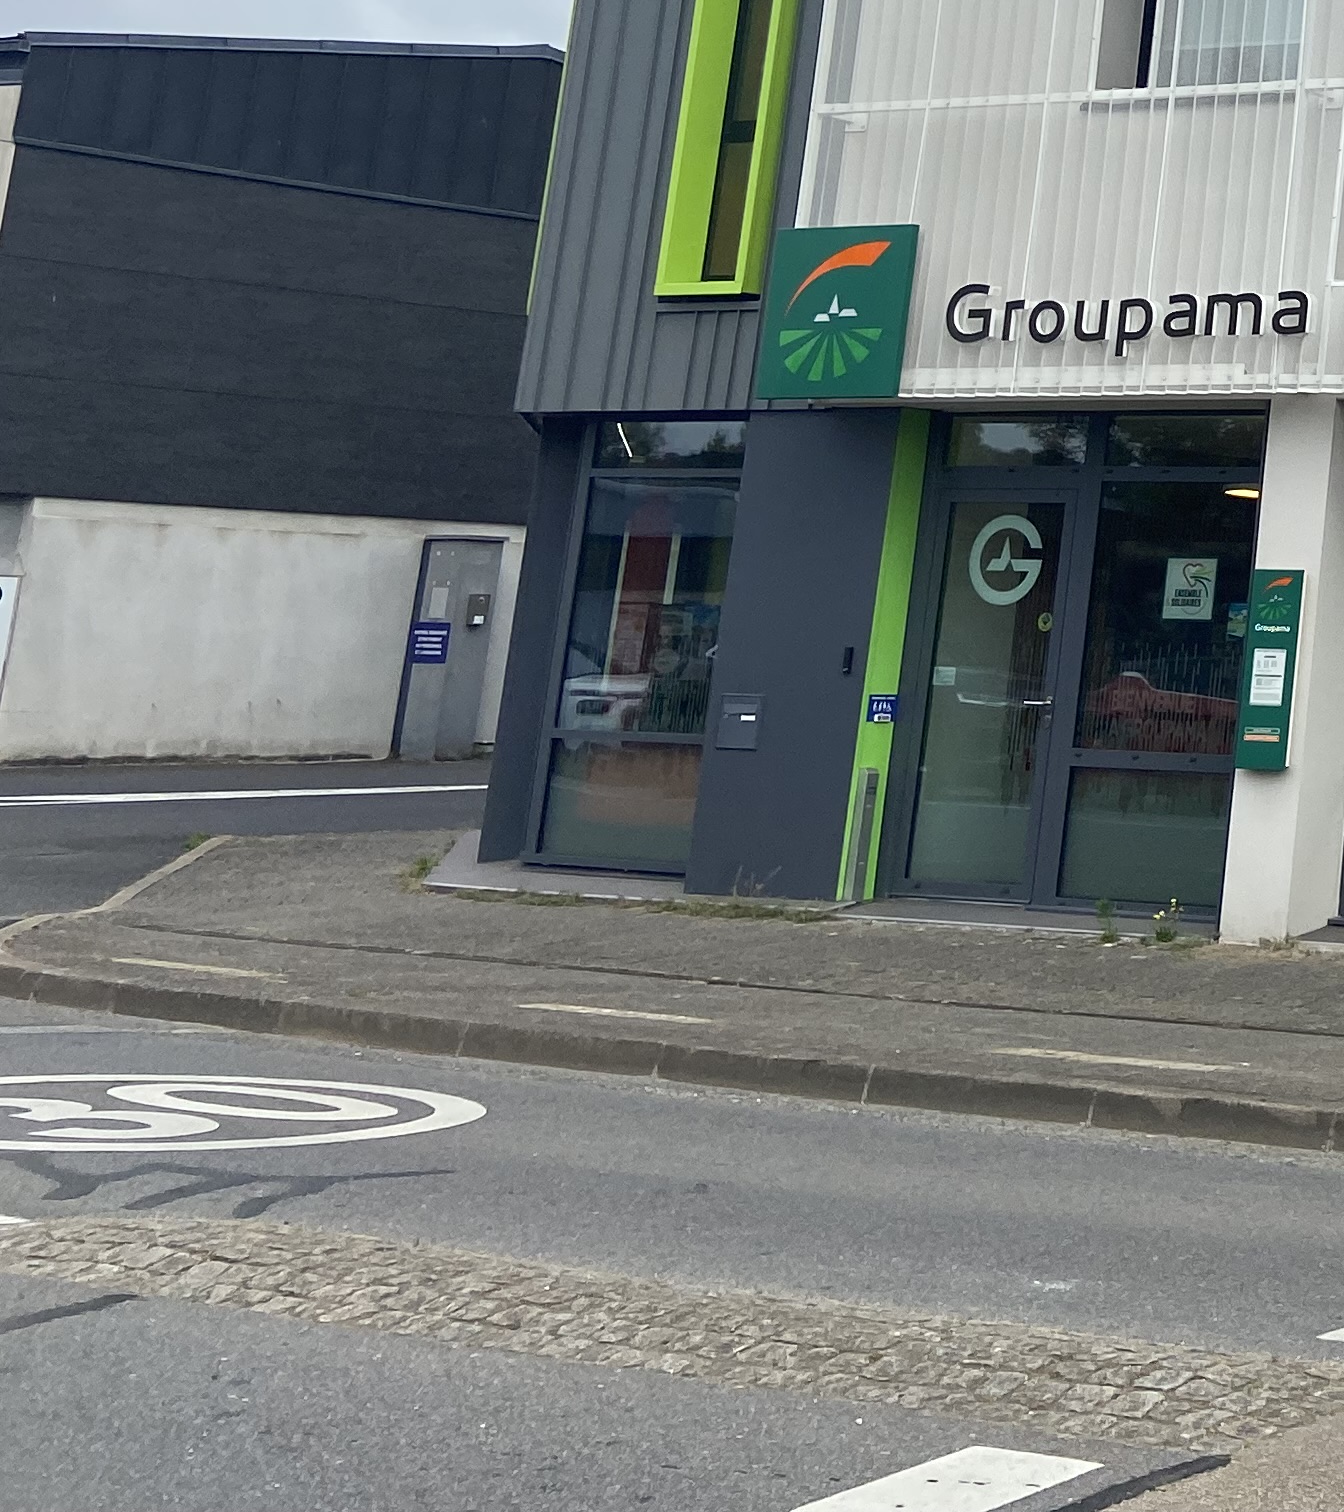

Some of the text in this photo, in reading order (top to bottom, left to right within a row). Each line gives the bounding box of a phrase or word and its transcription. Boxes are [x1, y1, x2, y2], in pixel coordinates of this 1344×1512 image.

[946, 284, 1309, 356] Groupama
[1254, 623, 1291, 633] Groupama
[0, 1083, 399, 1139] 30
